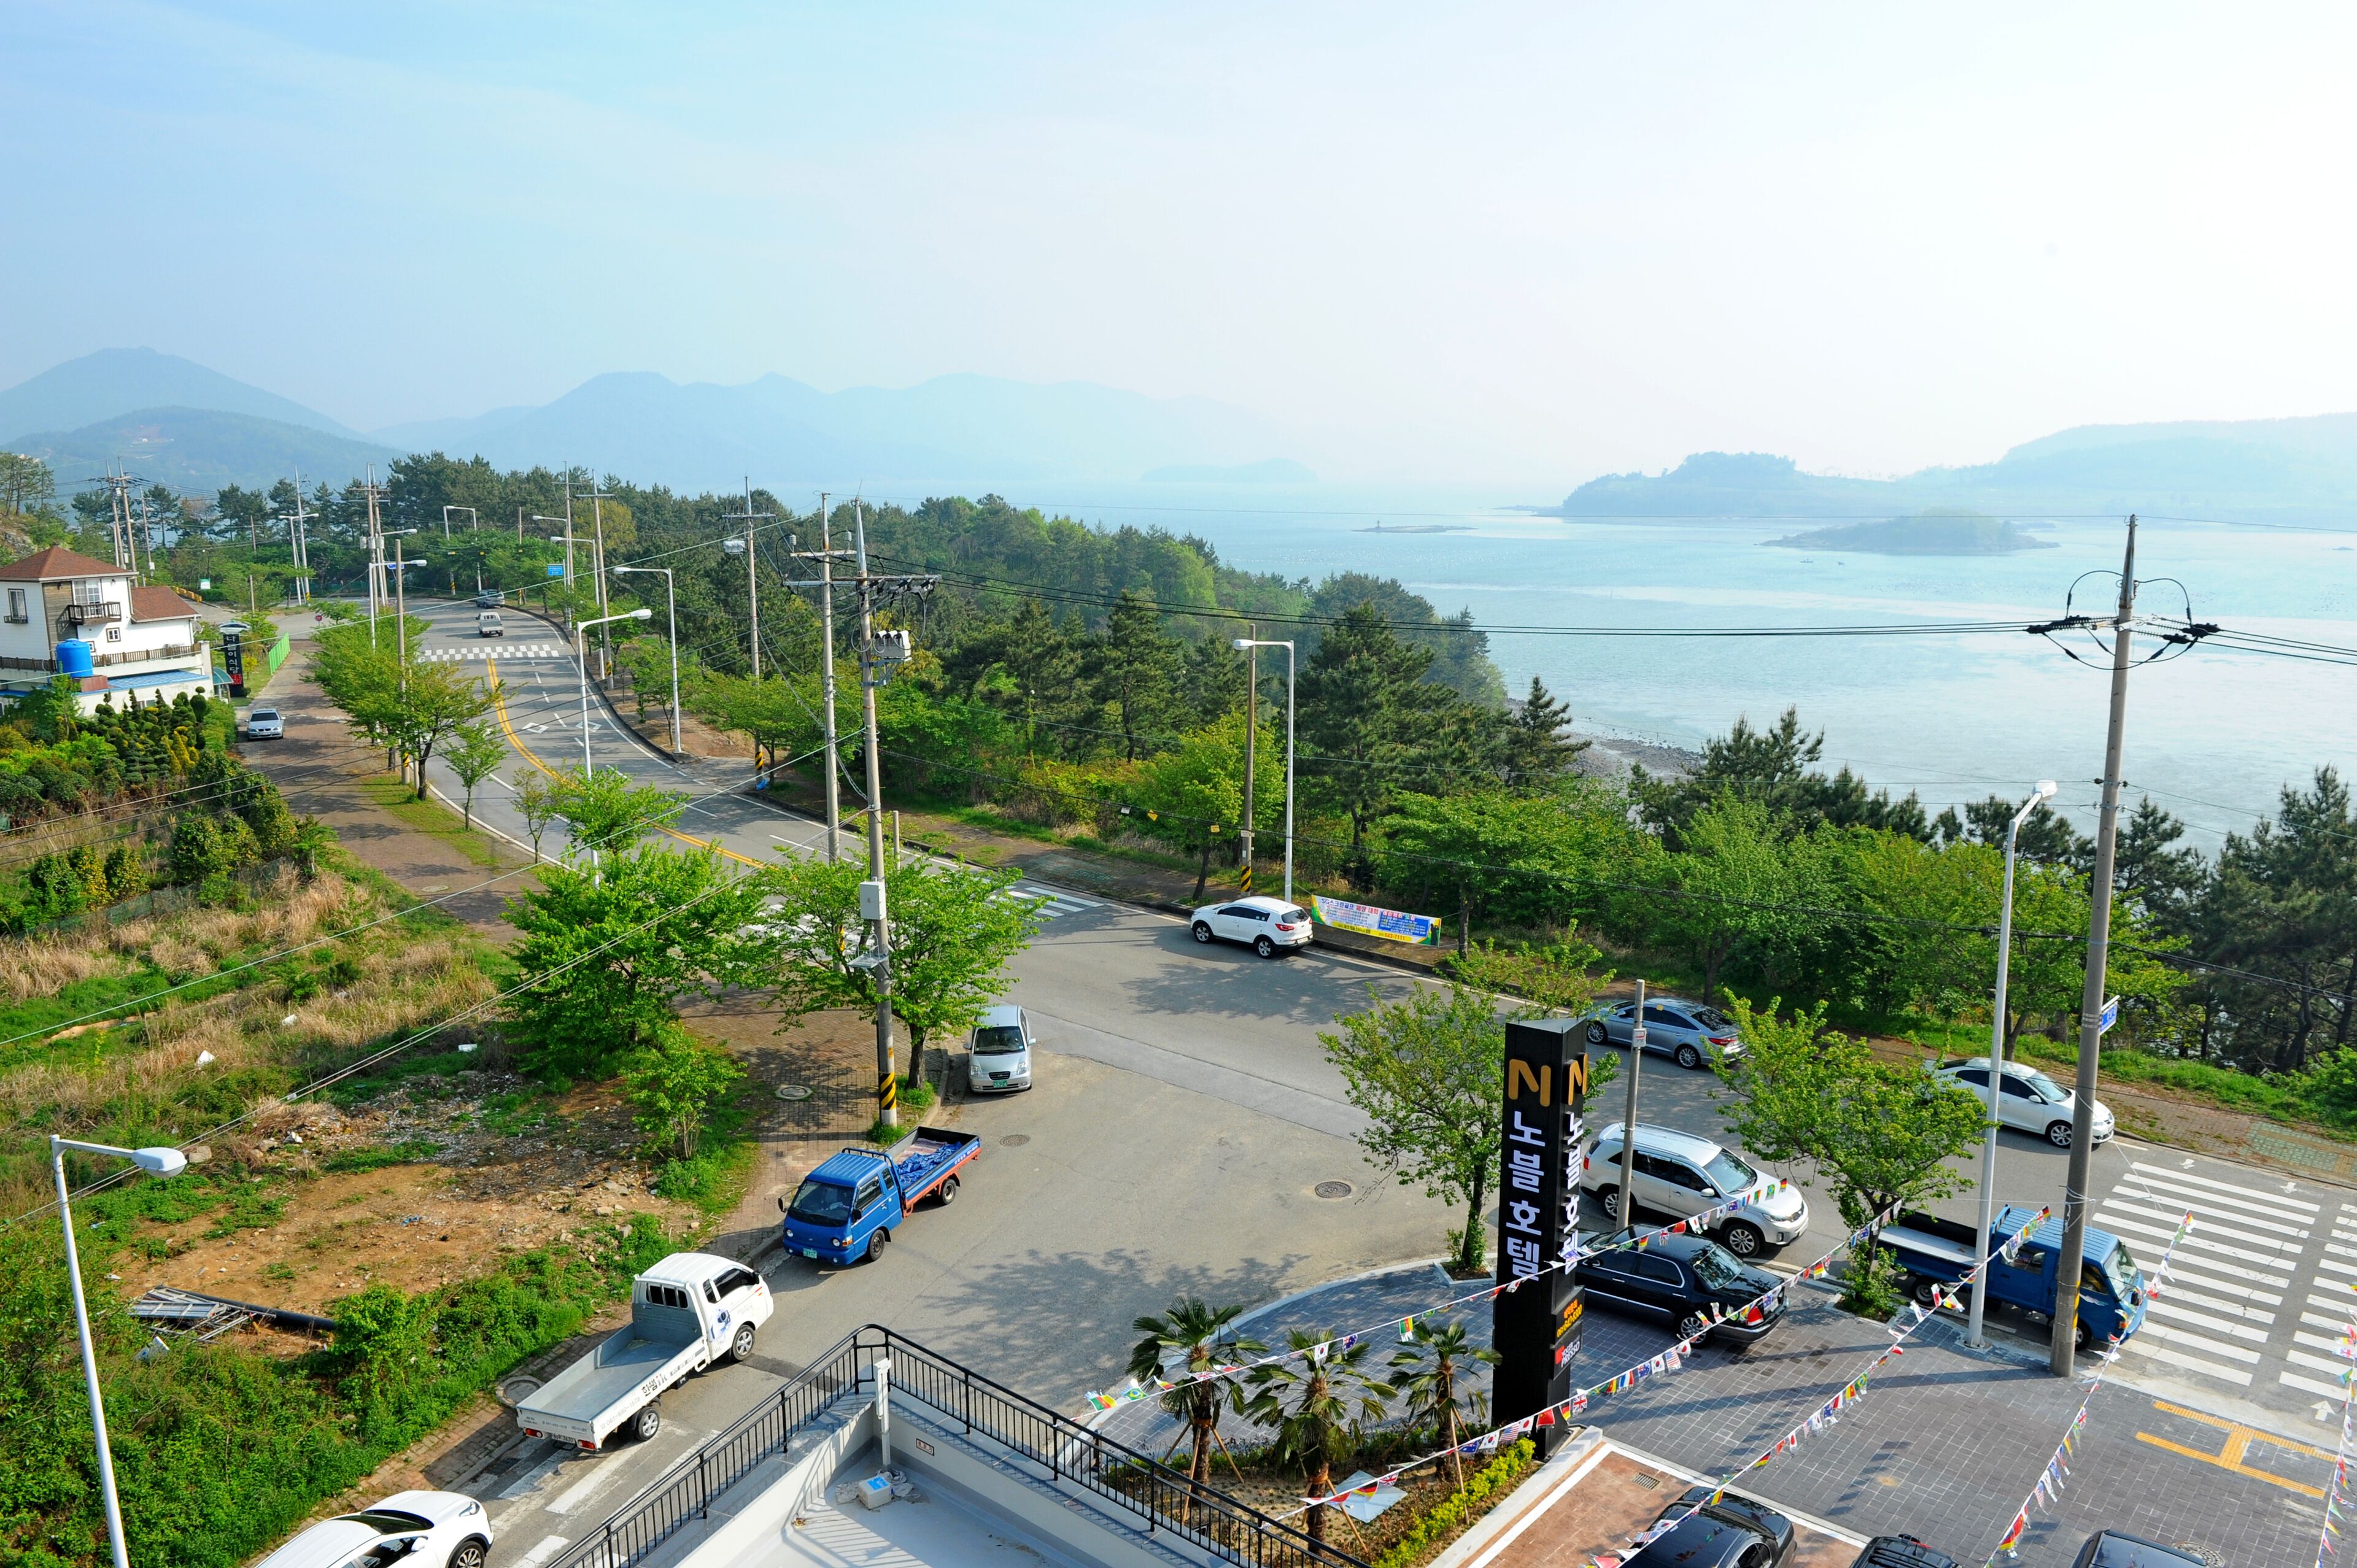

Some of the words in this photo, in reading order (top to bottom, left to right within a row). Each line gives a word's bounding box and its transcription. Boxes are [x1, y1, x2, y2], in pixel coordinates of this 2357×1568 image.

[226, 635, 240, 674] 나들이식당
[1322, 898, 1354, 910] SG스크린골프
[1384, 932, 1405, 941] 643-7111
[1506, 1110, 1546, 1281] 노블호텔
[1563, 1110, 1584, 1275] 노블호텔
[1561, 1341, 1580, 1368] PRESSO
